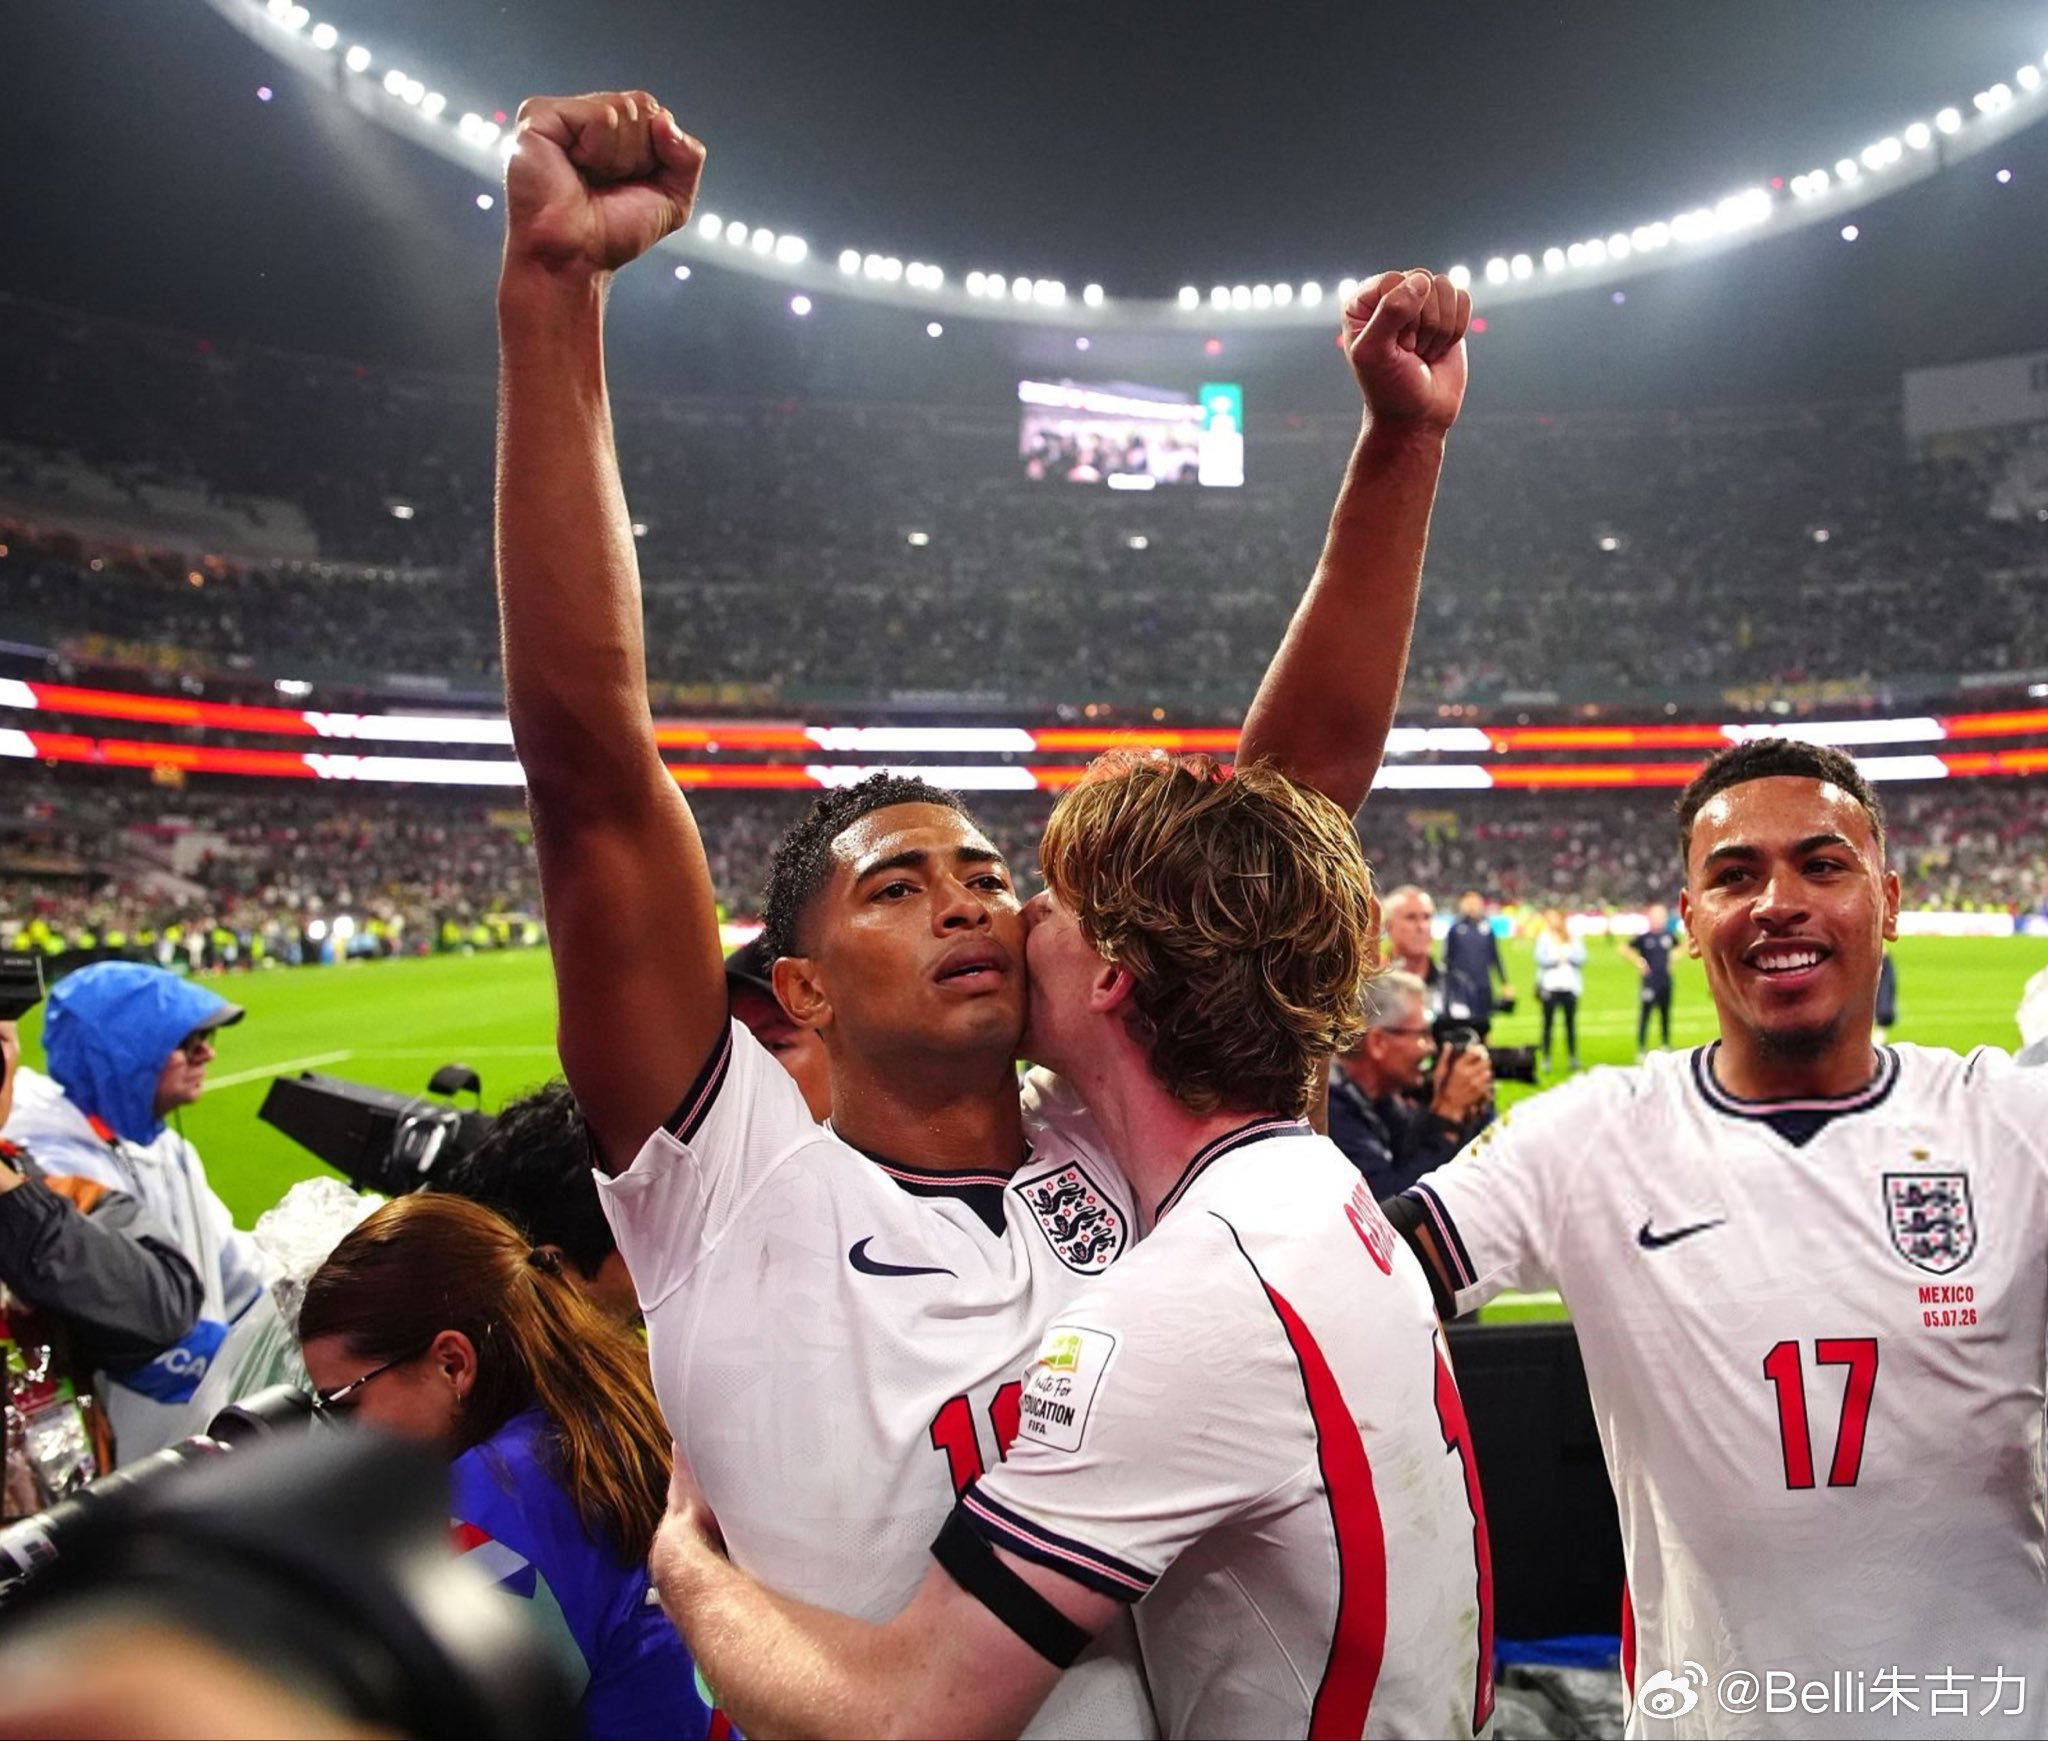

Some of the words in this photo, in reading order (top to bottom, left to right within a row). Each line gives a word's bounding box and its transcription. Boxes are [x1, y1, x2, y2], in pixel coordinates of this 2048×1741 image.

[1918, 1286, 1974, 1304] MEXICO
[1923, 1308, 1977, 1328] 05.07.26
[1053, 1377, 1071, 1398] For
[1763, 1337, 1878, 1490] 17
[1027, 1419, 1047, 1435] FIFA
